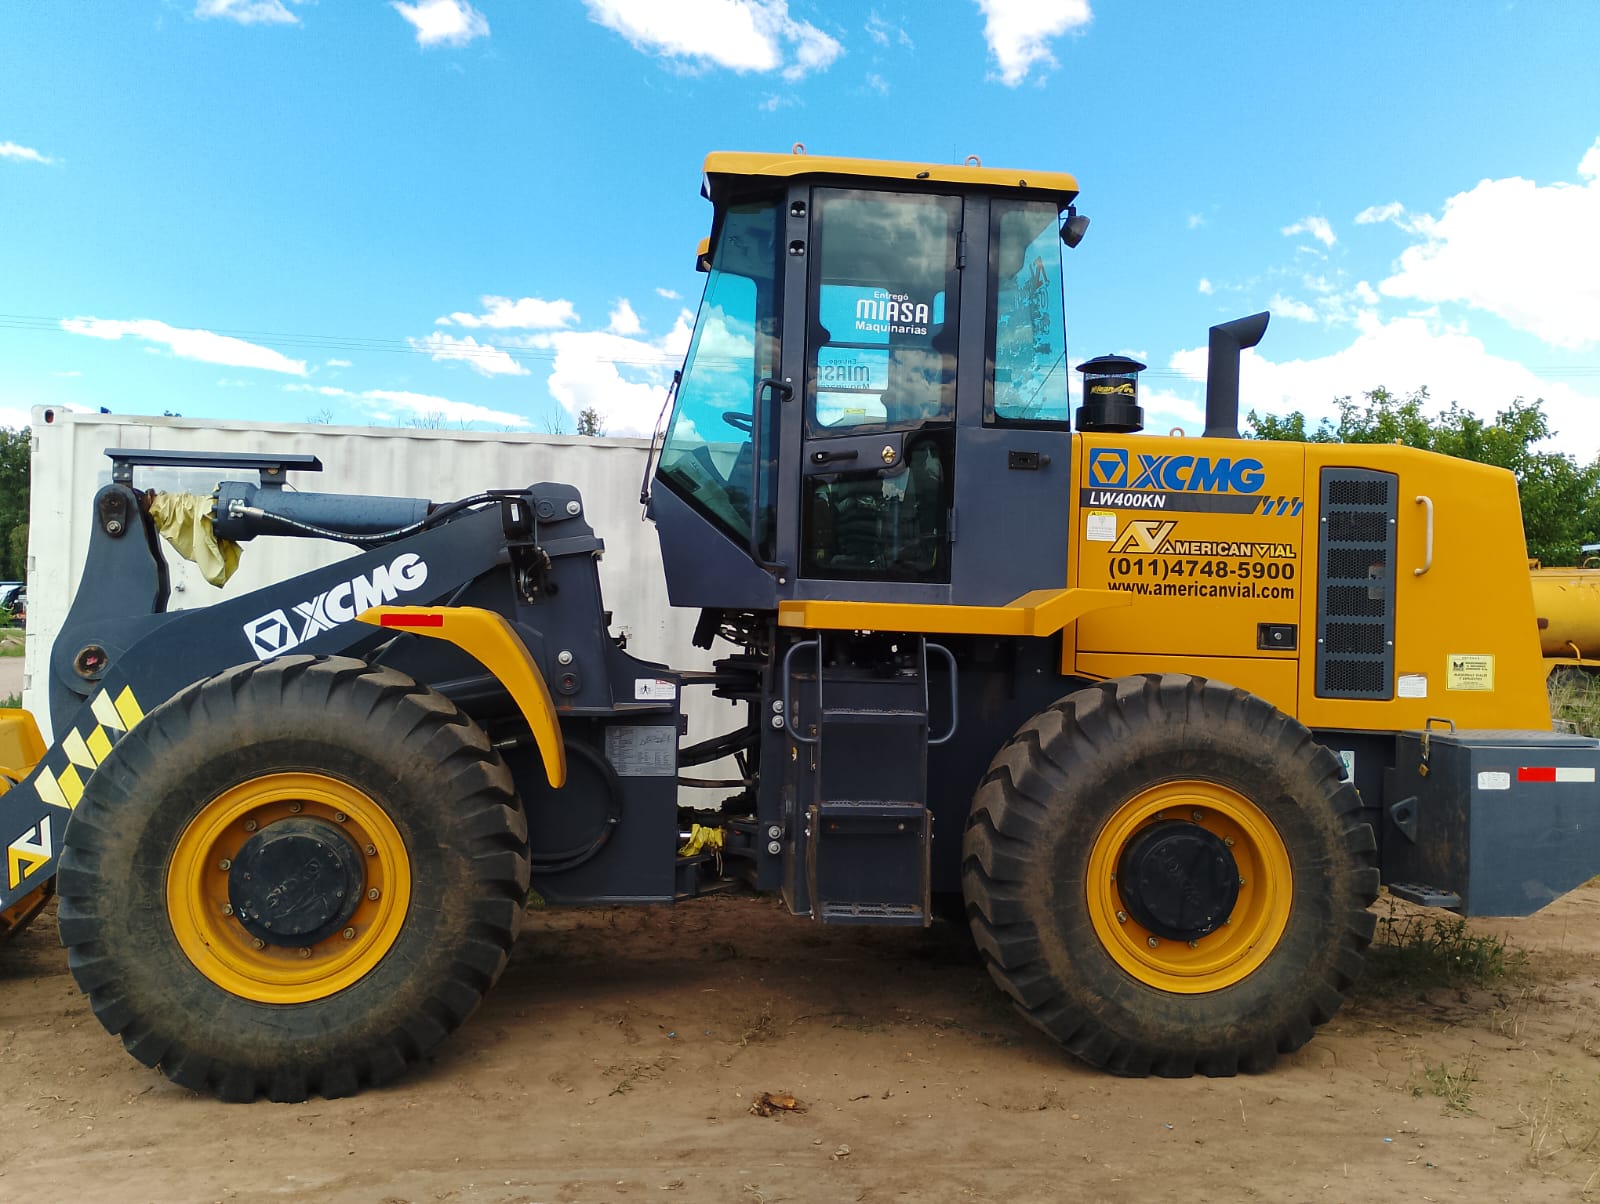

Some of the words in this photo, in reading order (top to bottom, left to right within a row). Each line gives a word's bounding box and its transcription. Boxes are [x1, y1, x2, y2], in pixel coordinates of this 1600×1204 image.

[873, 291, 909, 301] Entregó
[856, 299, 929, 324] MIASA
[855, 320, 928, 336] Maquinarias
[1128, 454, 1266, 494] XCMG
[1089, 492, 1166, 509] LW400KN
[1109, 557, 1295, 581] (011)4748-5900
[292, 552, 428, 643] XCMG
[1108, 580, 1295, 600] www.americanvial.com
